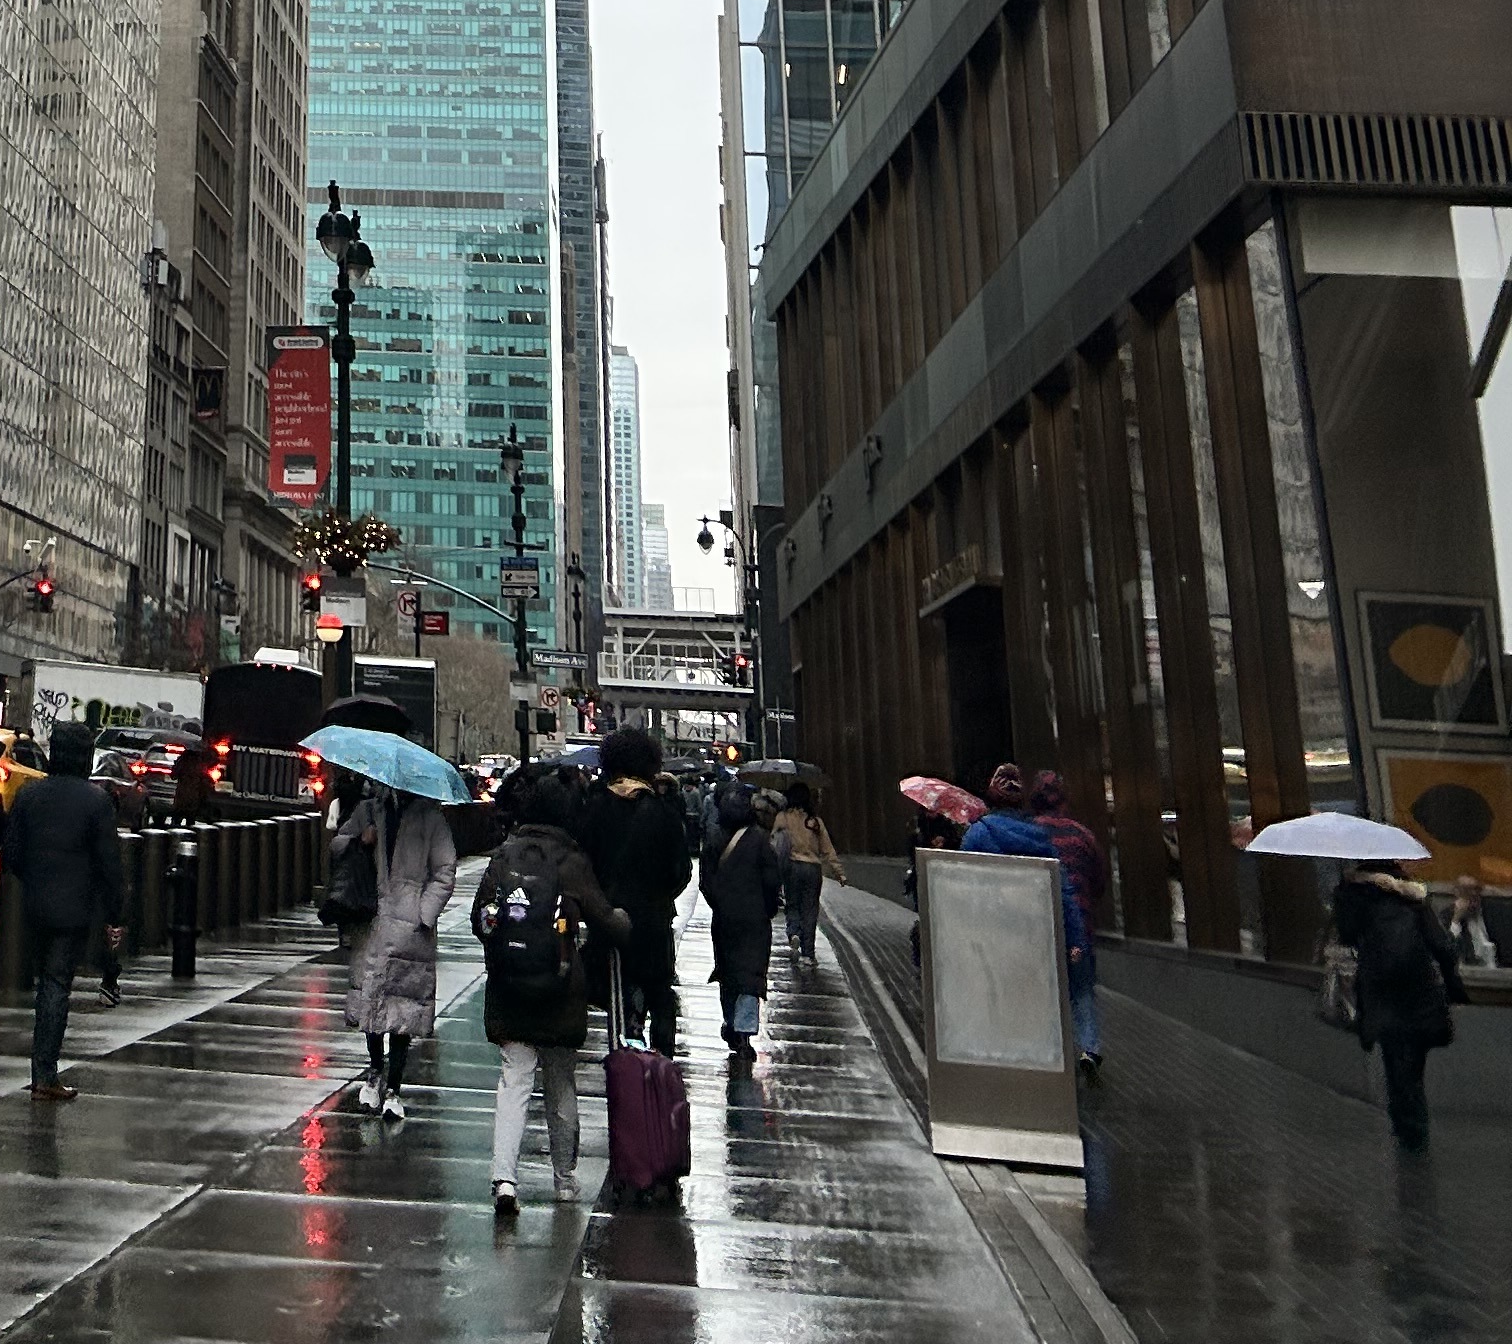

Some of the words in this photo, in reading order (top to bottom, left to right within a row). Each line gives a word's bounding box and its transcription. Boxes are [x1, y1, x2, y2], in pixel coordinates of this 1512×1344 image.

[534, 653, 570, 666] Madison
[570, 655, 587, 667] Ave
[232, 744, 247, 752] NY
[248, 746, 306, 758] WATERWAY
